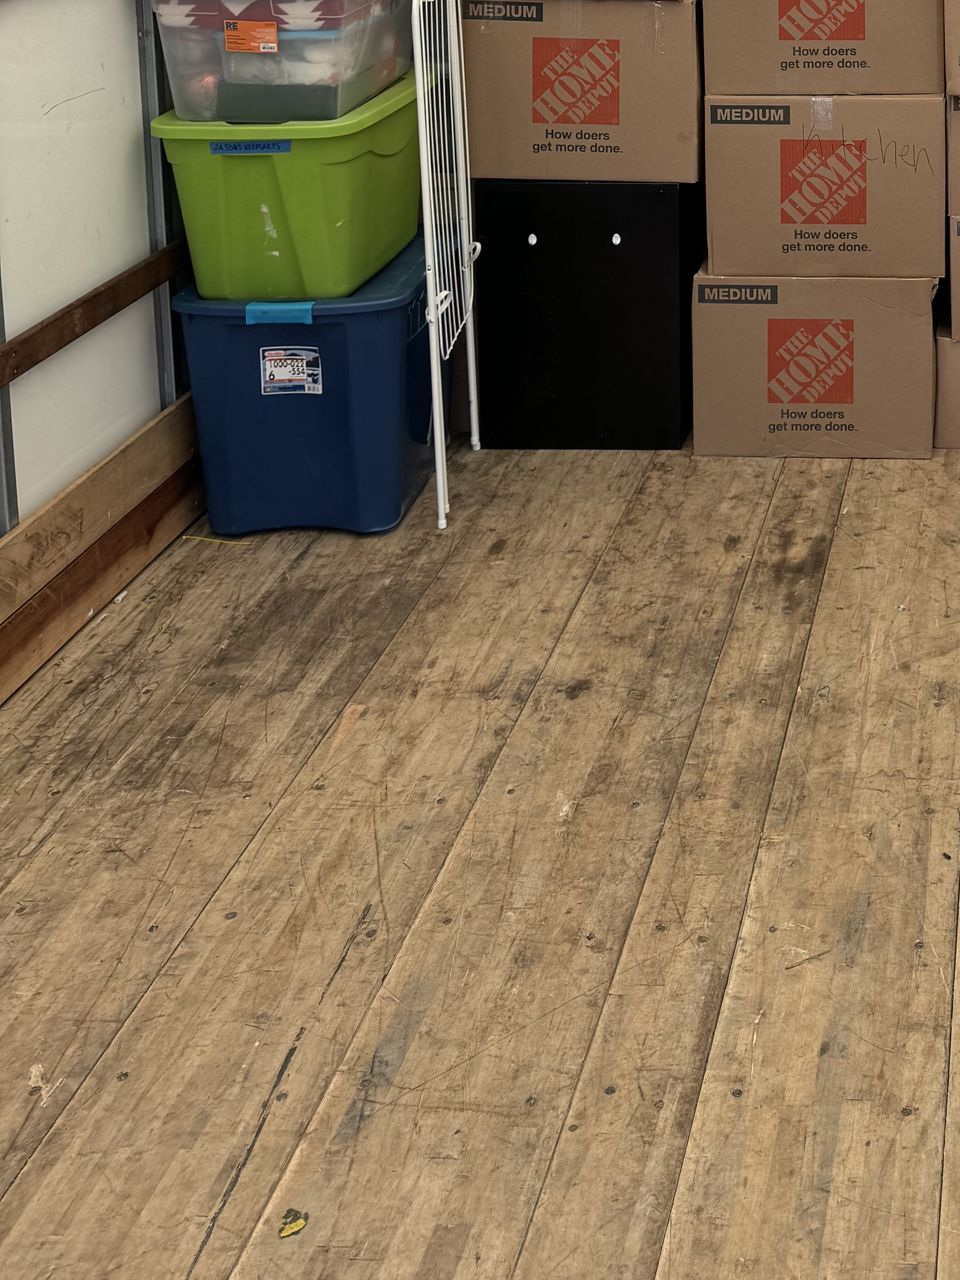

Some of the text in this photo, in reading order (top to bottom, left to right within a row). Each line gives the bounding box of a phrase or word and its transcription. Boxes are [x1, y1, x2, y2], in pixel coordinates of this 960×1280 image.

[468, 3, 537, 18] MEDIUM
[793, 46, 856, 56] How doers
[540, 47, 577, 80] THE
[780, 59, 800, 70] get
[837, 59, 870, 68] done.
[533, 39, 619, 123] HOME
[566, 71, 620, 124] DEPOT
[717, 108, 784, 121] MEDIUM
[545, 129, 610, 140] How doers
[533, 142, 552, 153] get
[590, 143, 623, 153] done.
[788, 149, 824, 183] THE
[781, 140, 867, 224] HOME
[815, 172, 867, 225] DEPOT
[794, 229, 858, 240] How doers
[782, 242, 801, 253] get
[838, 242, 872, 252] done.
[704, 288, 772, 301] MEDIUM
[775, 327, 812, 362] THE
[768, 319, 854, 403] HOME
[268, 370, 275, 381] 6
[801, 351, 854, 404] DEPOT
[780, 409, 845, 419] How doers
[768, 422, 858, 433] get more done.
